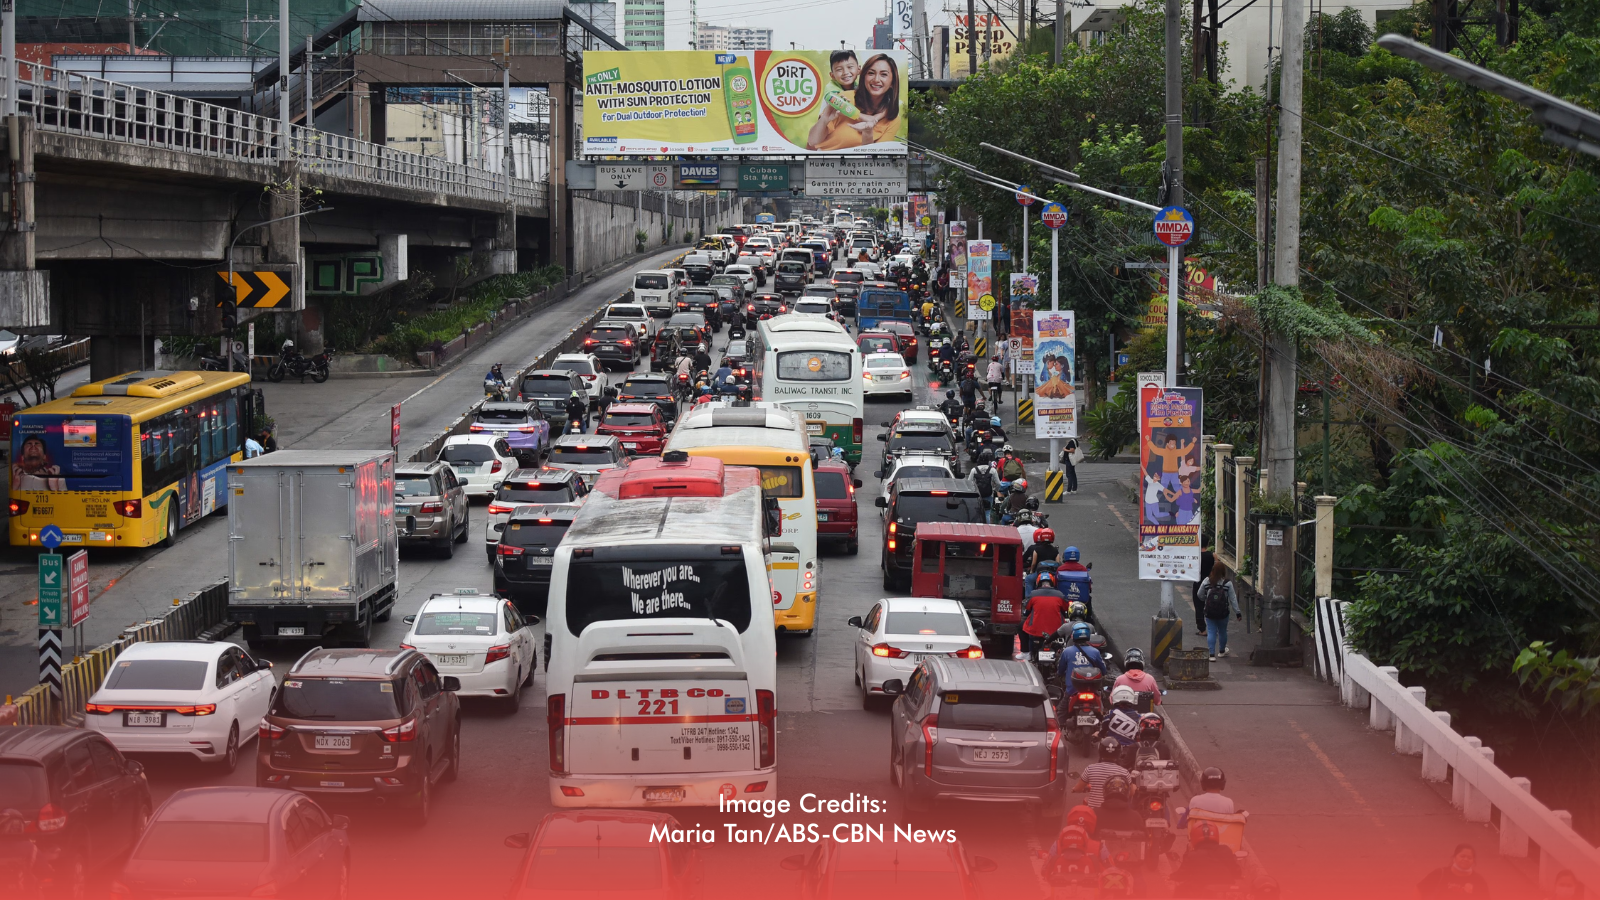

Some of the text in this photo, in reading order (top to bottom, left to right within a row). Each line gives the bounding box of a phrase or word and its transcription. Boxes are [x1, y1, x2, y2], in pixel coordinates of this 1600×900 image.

[955, 14, 1001, 27] MESA
[717, 55, 734, 63] NEW!
[597, 70, 619, 82] ONLY
[586, 78, 721, 96] ANTI-MOSQUITO LOTION
[772, 78, 814, 96] BUG
[598, 93, 711, 109] WITH SUN PROTECTION
[776, 96, 802, 107] SUN
[602, 108, 706, 122] for Dual Outdoor Protection!
[681, 167, 718, 176] DAVIES
[1156, 222, 1190, 233] MMDA
[774, 386, 806, 394] BALIWAG
[36, 495, 49, 503] 2113
[1141, 525, 1155, 534] TARA
[622, 564, 700, 590] Wherever you are...
[631, 589, 690, 614] We are there...
[638, 699, 679, 715] 221
[681, 728, 696, 736] LTFRB
[708, 727, 726, 736] Hotline:
[727, 727, 739, 735] 1342
[670, 735, 750, 744] Text/Viber Hotlines: 0917-550-1342
[992, 751, 1009, 759] 2573
